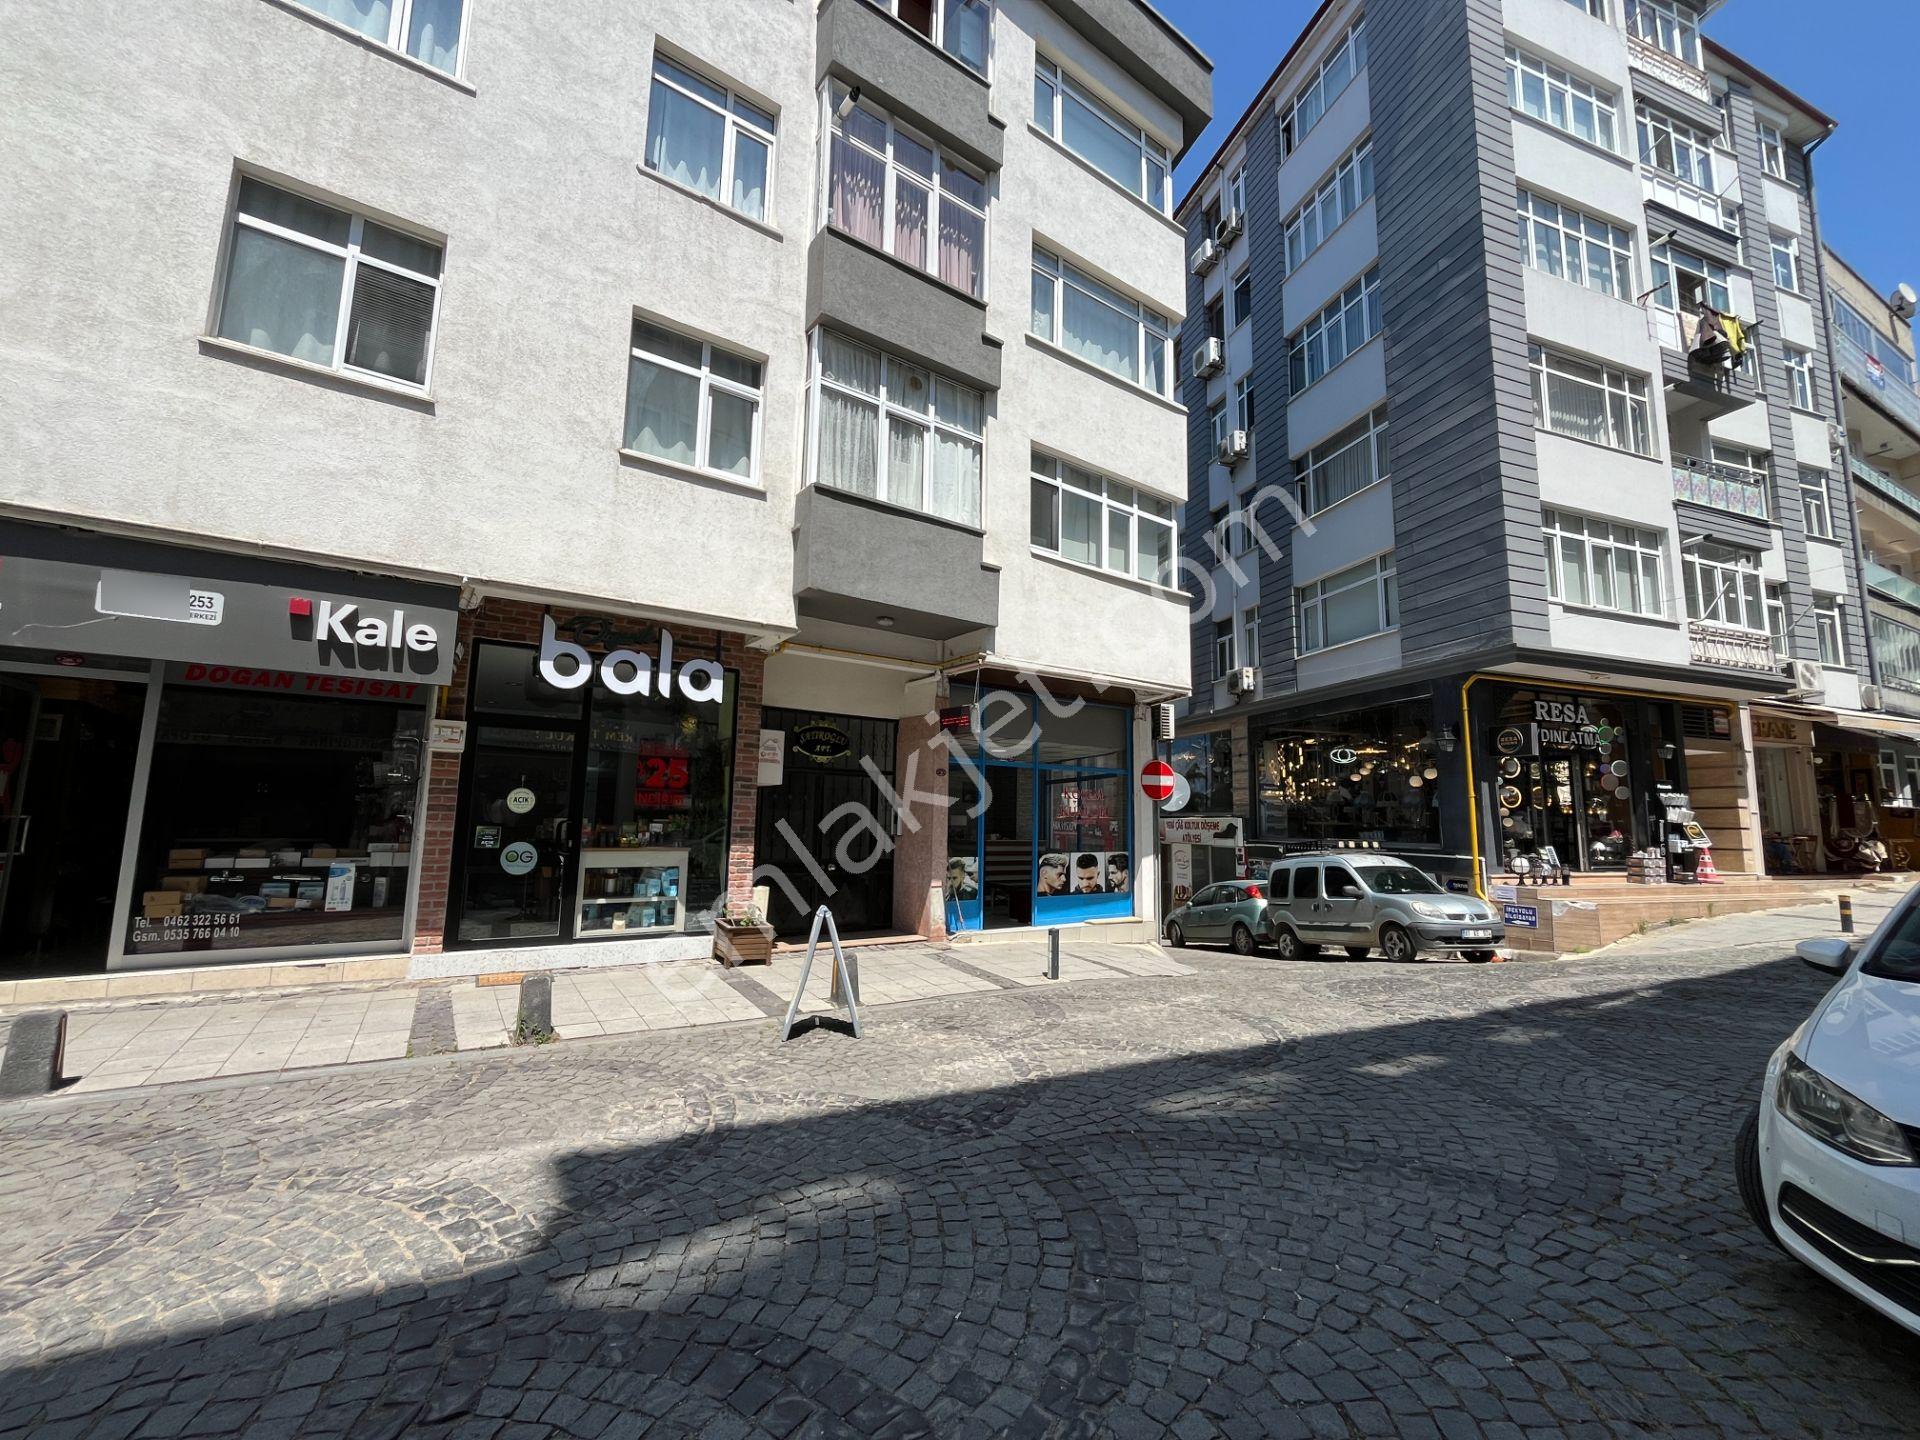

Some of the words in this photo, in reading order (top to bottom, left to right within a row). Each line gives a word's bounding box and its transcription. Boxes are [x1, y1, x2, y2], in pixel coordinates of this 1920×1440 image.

[190, 612, 217, 621] ERKEZİ
[316, 600, 438, 651] Kale
[539, 614, 725, 704] bala
[1534, 700, 1590, 724] RESA
[134, 916, 153, 928] Tel.
[163, 915, 190, 927] 0462
[192, 914, 212, 926] 322
[213, 914, 227, 925] 56
[229, 912, 241, 924] 61
[132, 931, 160, 942] Gsm.
[163, 929, 190, 940] 0535
[193, 928, 211, 939] 766
[213, 927, 227, 938] 04
[230, 926, 240, 937] 10
